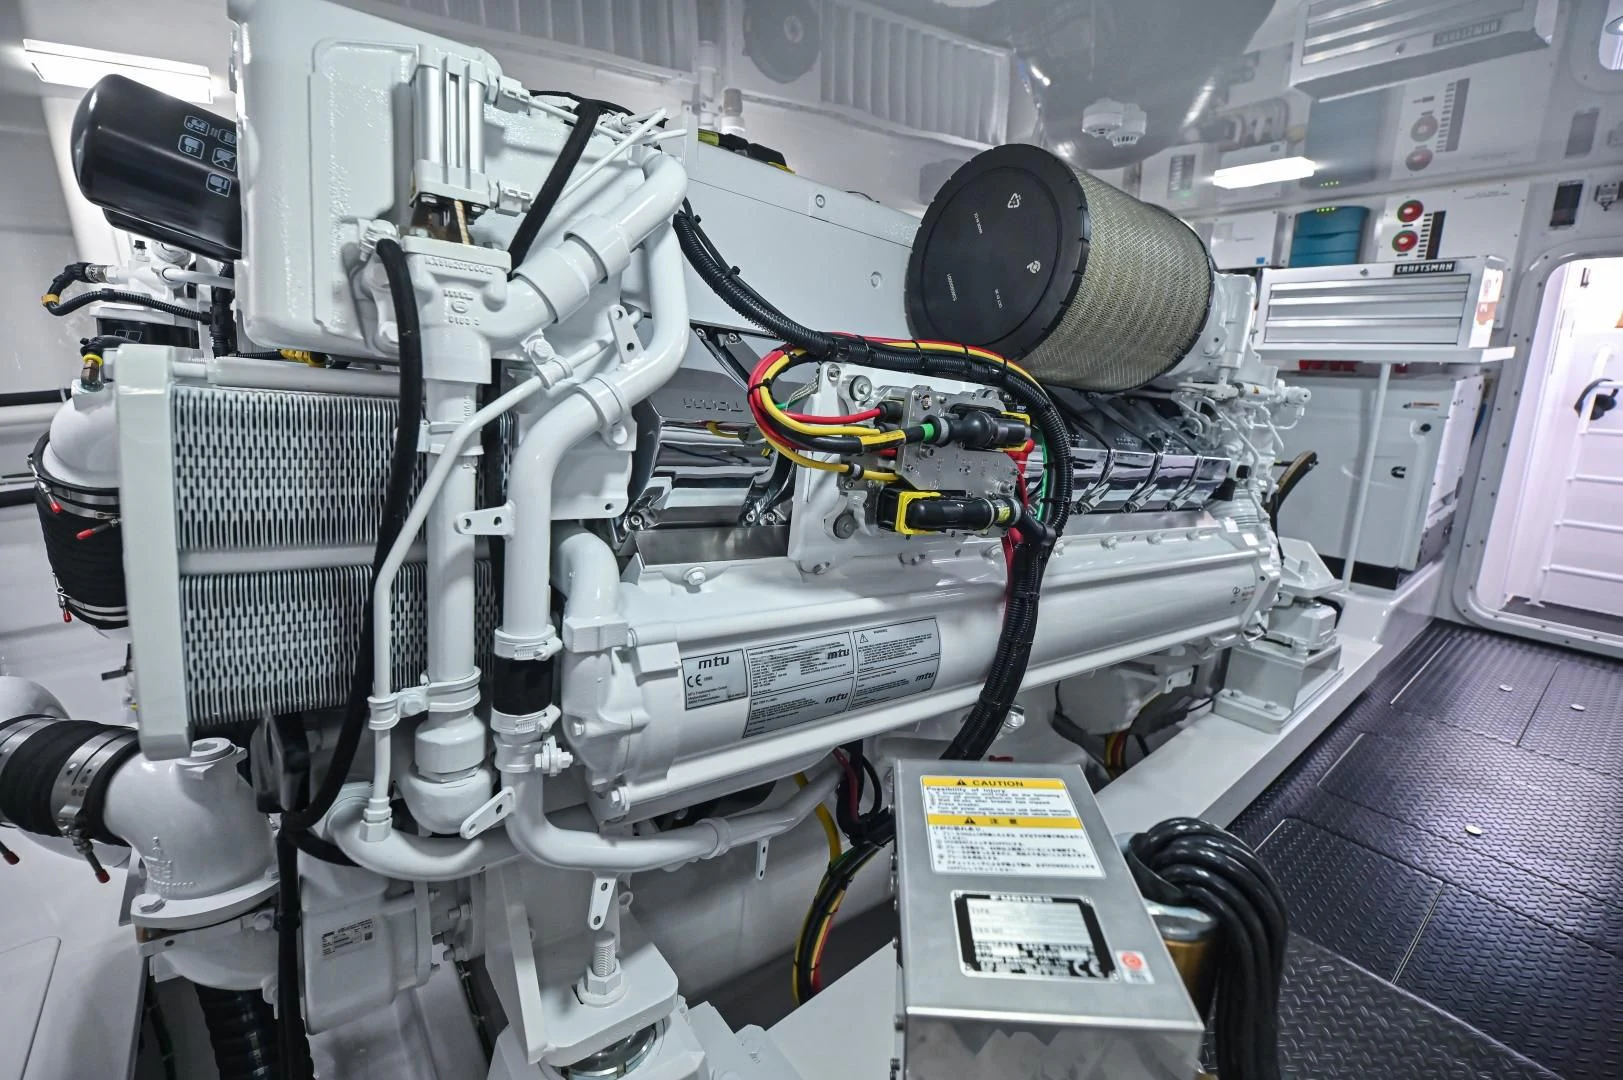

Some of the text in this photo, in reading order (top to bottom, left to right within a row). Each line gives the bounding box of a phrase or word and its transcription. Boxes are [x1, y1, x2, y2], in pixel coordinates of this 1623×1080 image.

[1396, 263, 1453, 273] CRAFTSMAN
[827, 649, 850, 660] mtu
[698, 656, 730, 670] mtu
[687, 674, 703, 688] CE
[915, 672, 935, 682] mtu
[825, 693, 849, 704] mtu
[972, 780, 1024, 788] CAUTION
